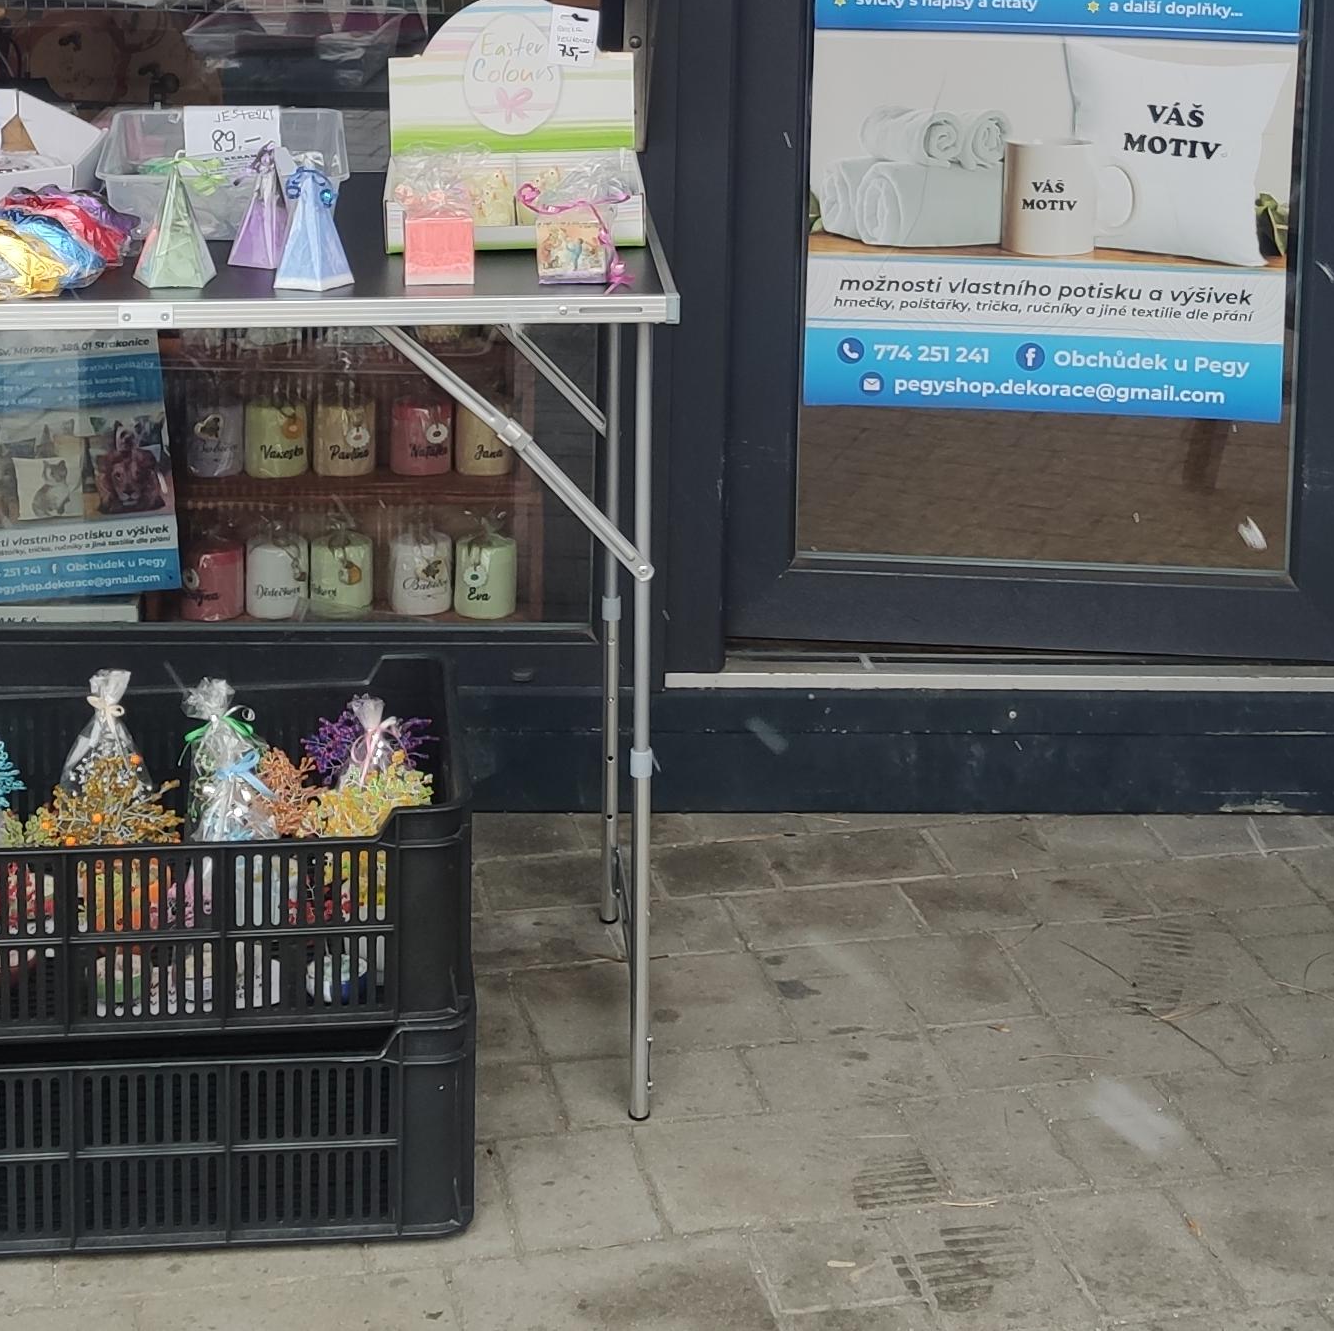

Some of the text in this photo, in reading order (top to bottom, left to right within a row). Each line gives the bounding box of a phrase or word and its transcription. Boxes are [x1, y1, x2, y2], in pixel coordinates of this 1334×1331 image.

[978, 0, 989, 10] a
[1109, 3, 1119, 14] a
[1123, 0, 1161, 17] další
[481, 32, 545, 57] Easter
[472, 58, 554, 82] Colours
[1147, 101, 1205, 129] VÁŠ
[1122, 132, 1223, 161] MOTIV
[1031, 178, 1065, 195] VÁŠ
[1021, 197, 1077, 212] MOTIV
[839, 274, 1252, 307] možnosti vlastního potisku a výšivek
[873, 343, 990, 364] 774 251 241
[1053, 347, 1250, 379] Obchůdek u Pegy
[894, 375, 1225, 406] pegyshop.dekorace@gmail.com
[12, 533, 67, 547] vlastního
[69, 530, 113, 543] potisku
[116, 528, 124, 538] a
[126, 524, 169, 538] výšivek
[66, 559, 125, 573] Obchůdek
[138, 557, 167, 570] Pegy
[467, 586, 491, 602] Eva
